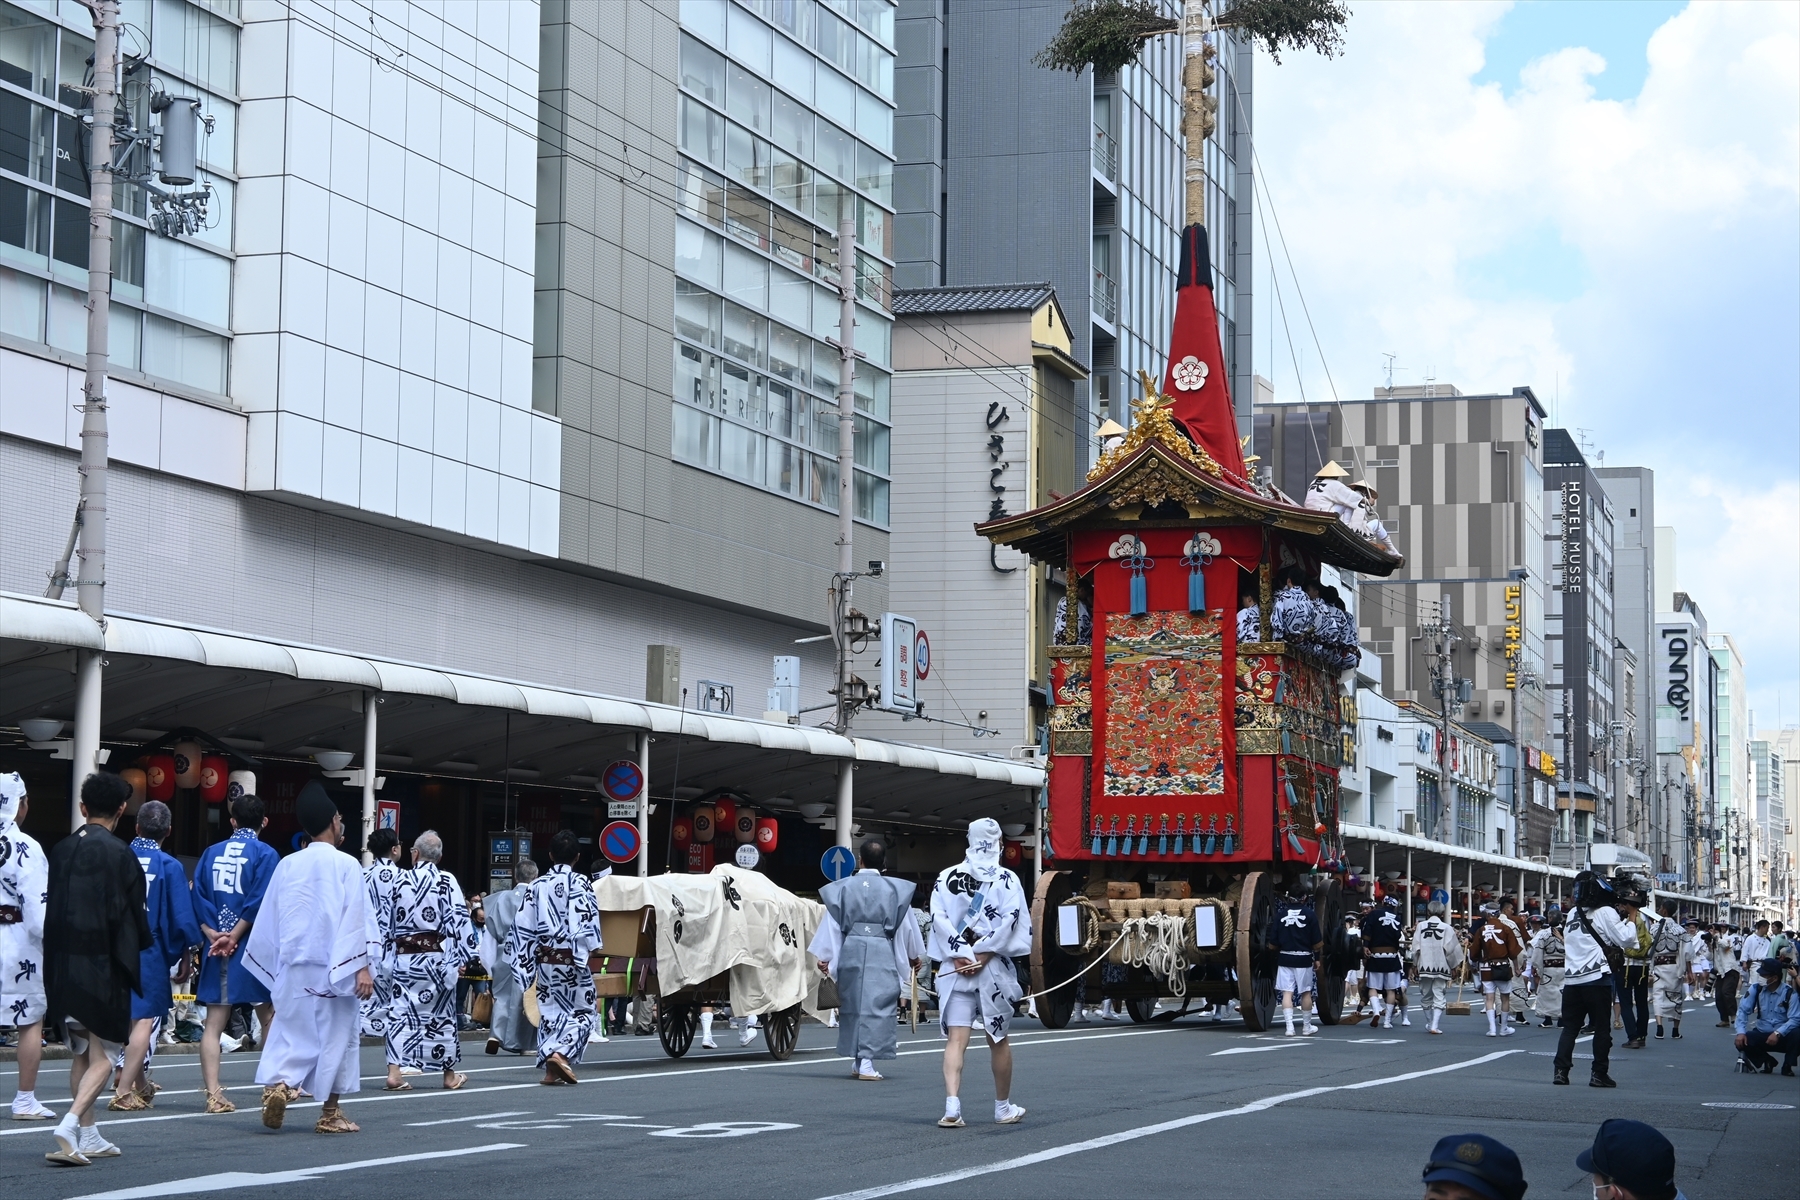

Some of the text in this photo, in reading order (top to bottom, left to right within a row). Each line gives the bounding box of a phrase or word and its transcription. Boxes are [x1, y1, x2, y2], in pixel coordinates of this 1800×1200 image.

[1568, 481, 1581, 593] HOTEL MUSSE
[917, 644, 927, 667] 40
[276, 782, 295, 797] THE
[531, 806, 548, 819] THE
